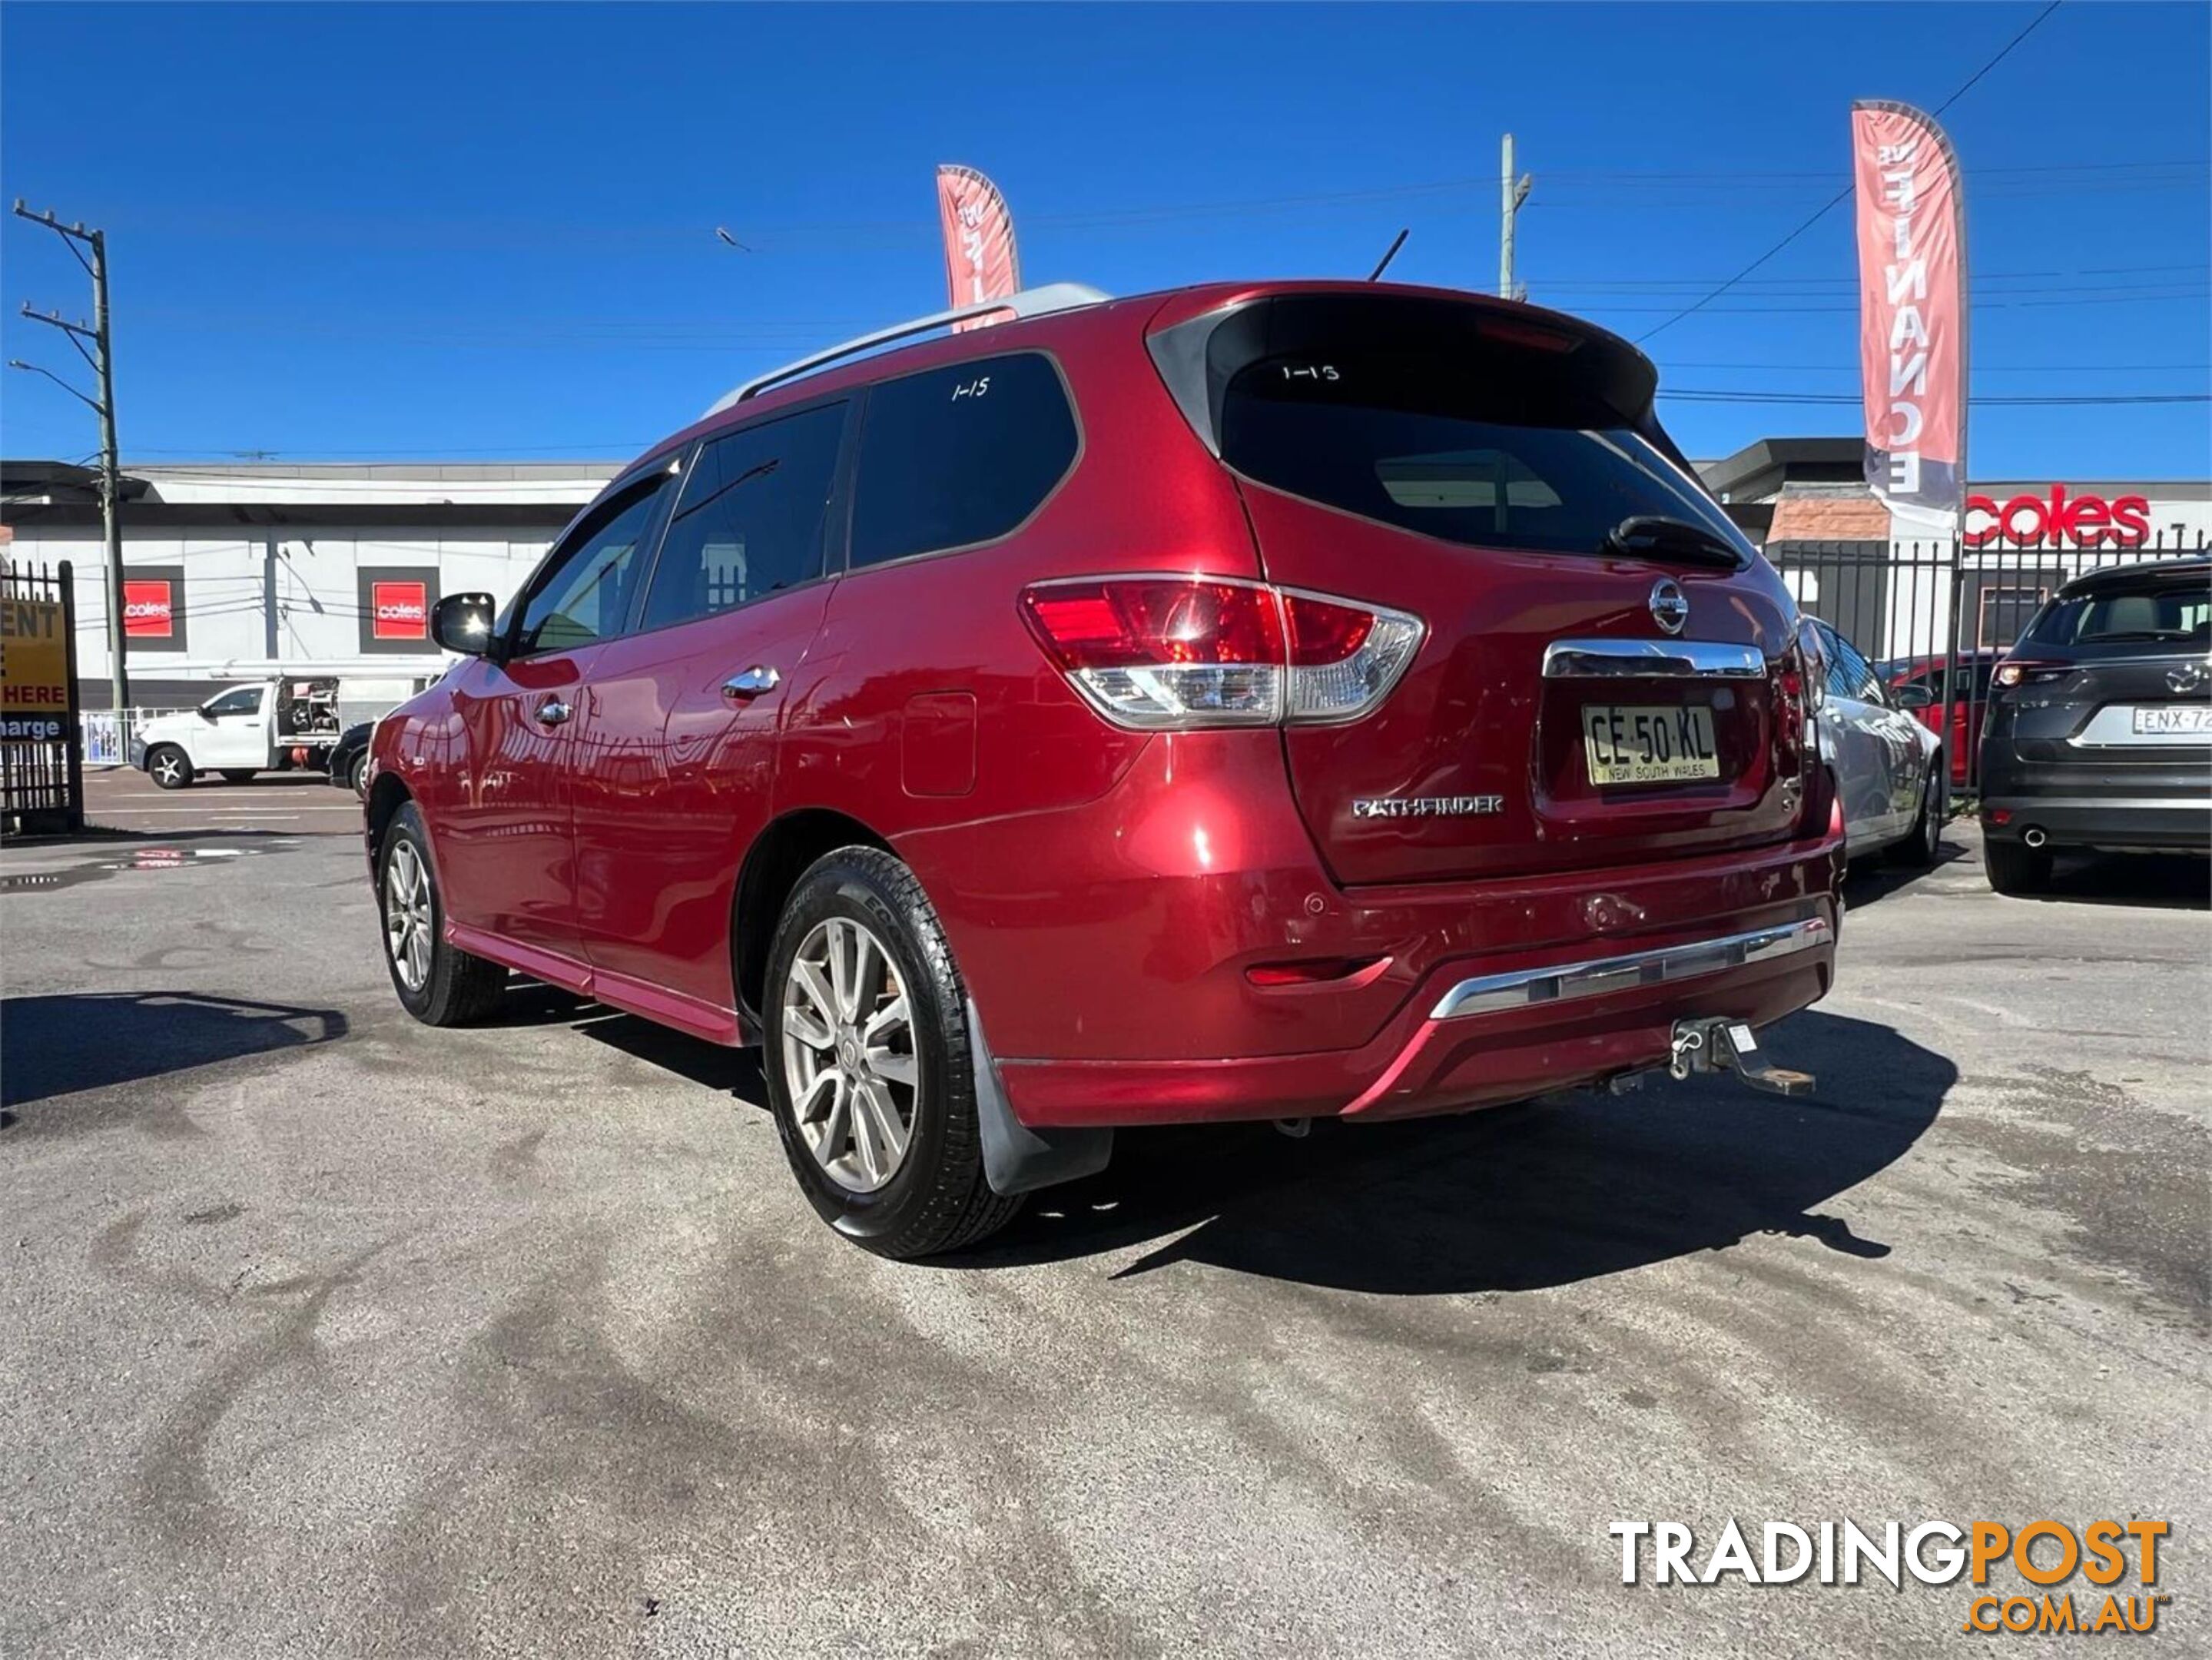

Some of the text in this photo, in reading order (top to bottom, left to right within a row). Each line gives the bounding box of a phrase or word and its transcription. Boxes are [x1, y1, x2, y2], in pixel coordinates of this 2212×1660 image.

[1963, 483, 2150, 548] coles
[125, 603, 171, 617] coles
[379, 603, 423, 619] coles
[4, 686, 65, 704] HERE
[1609, 764, 1706, 780] NEW SOUTH WALES
[1352, 795, 1504, 818] PATHFINDER
